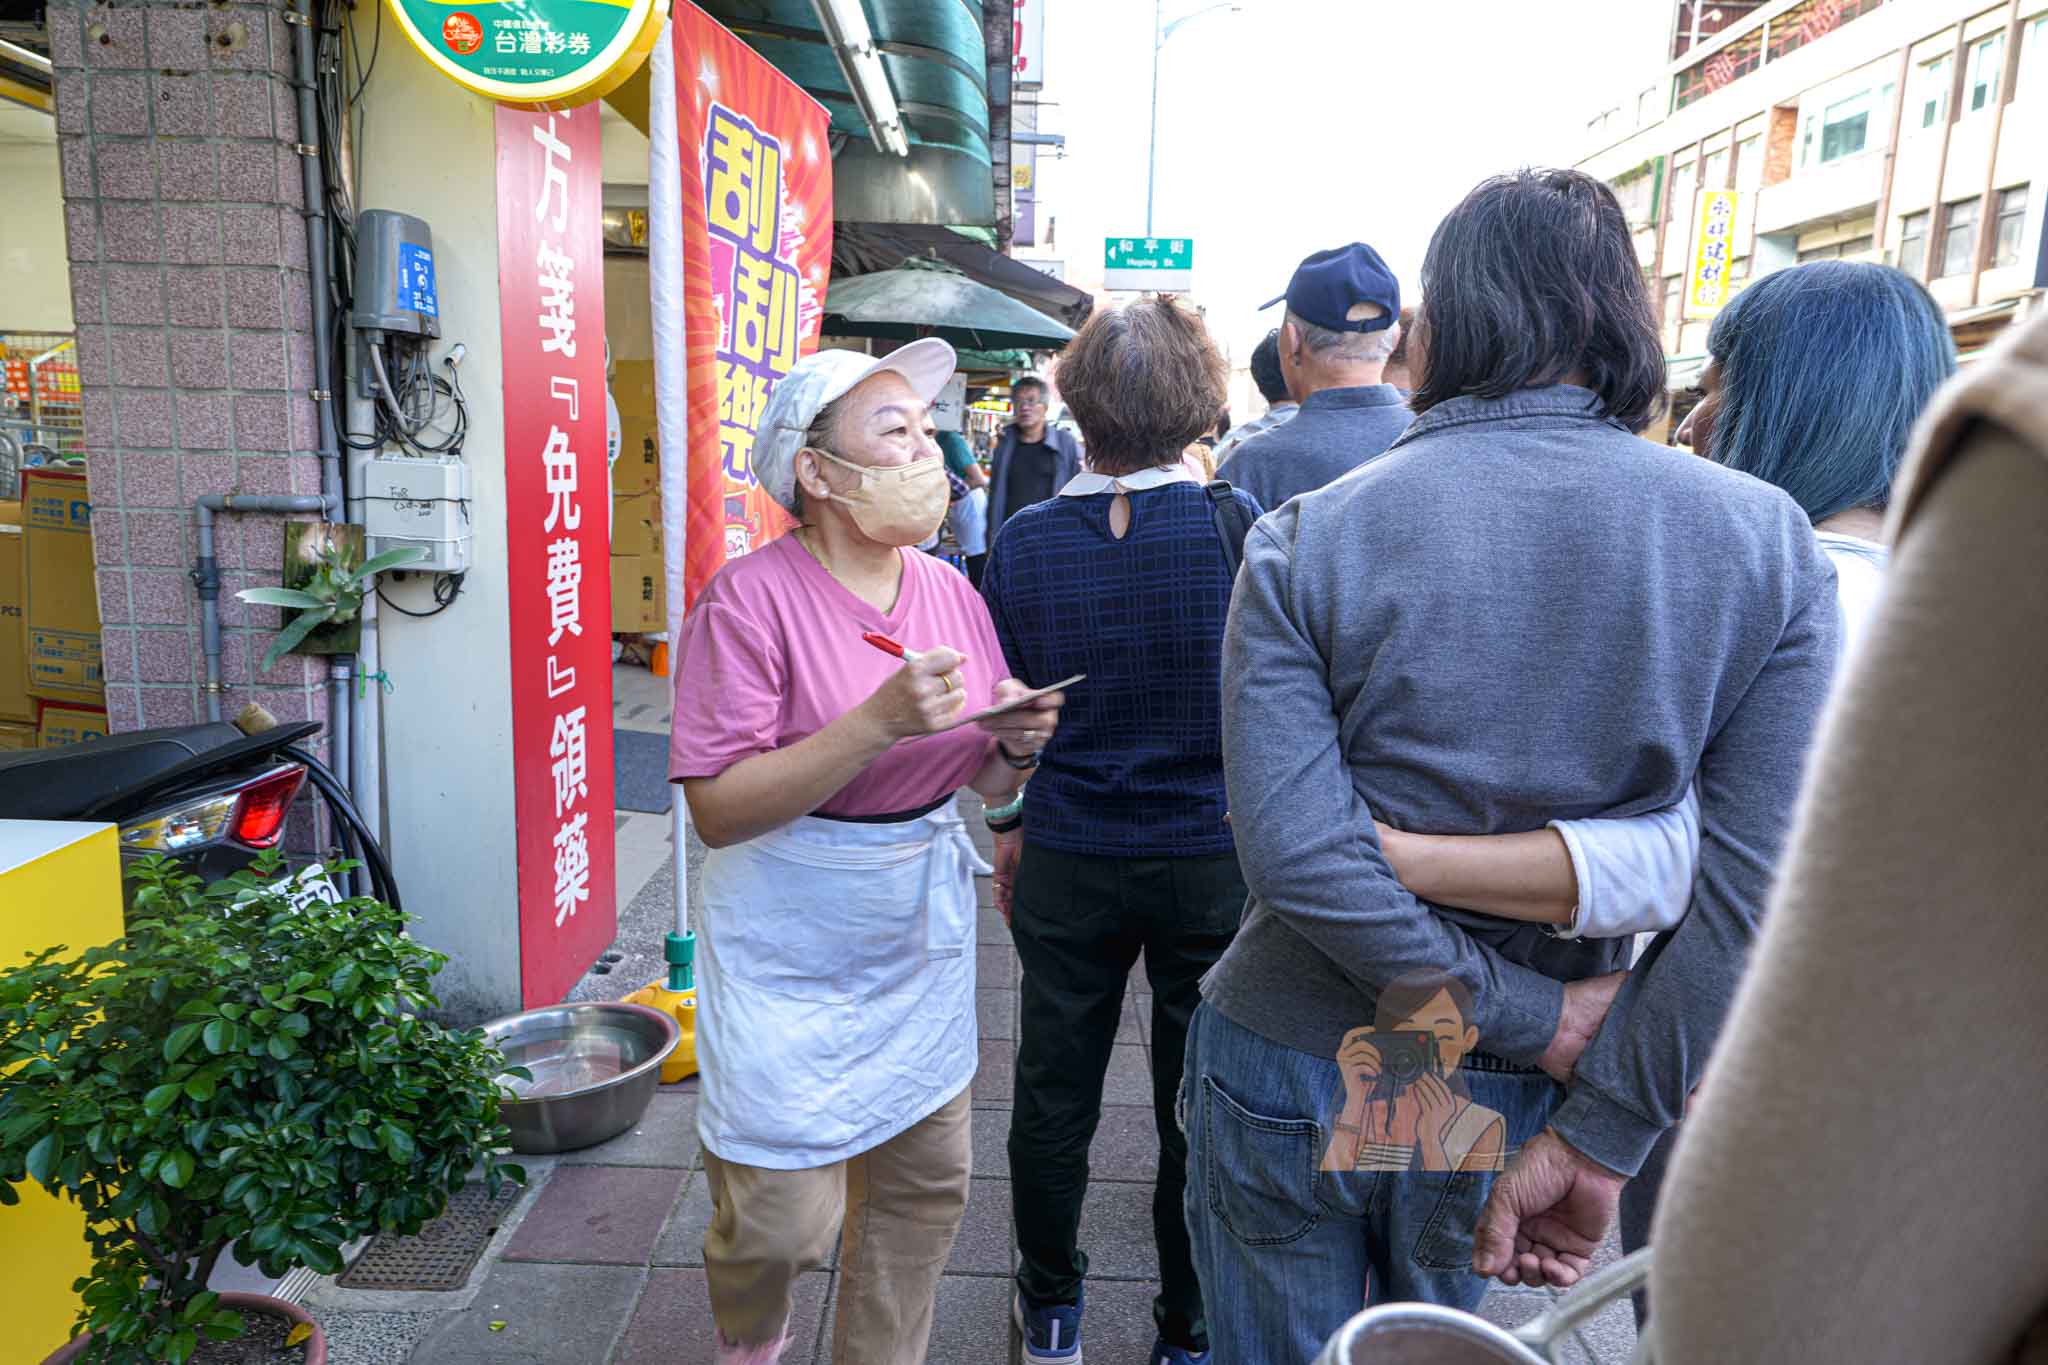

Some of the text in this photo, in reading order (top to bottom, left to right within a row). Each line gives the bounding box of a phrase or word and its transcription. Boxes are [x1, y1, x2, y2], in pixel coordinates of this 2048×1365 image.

[495, 31, 591, 54] 台灣彩券
[1120, 240, 1184, 254] 和平街
